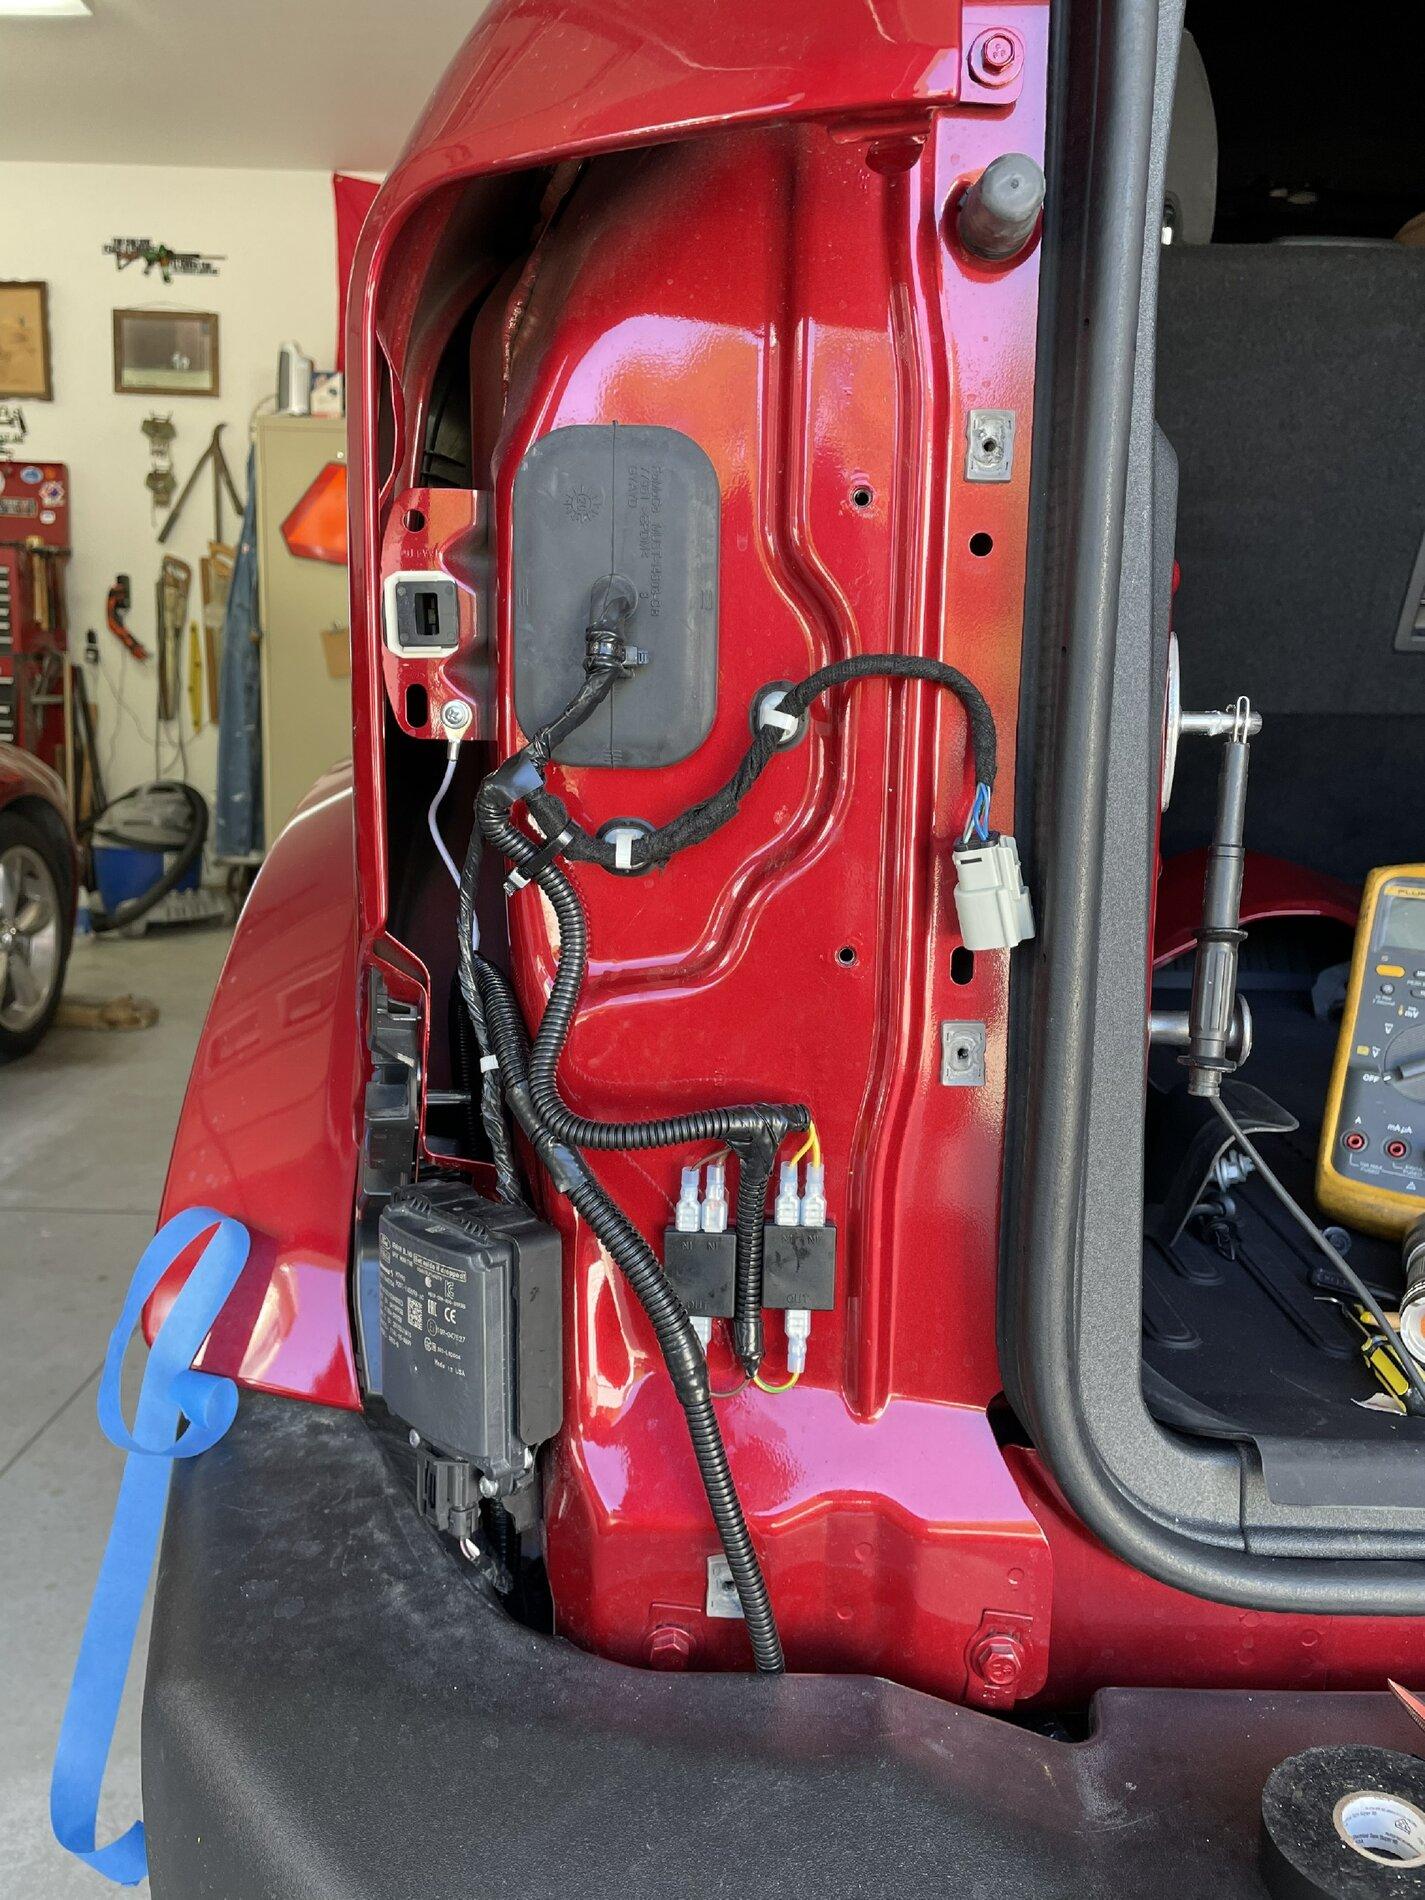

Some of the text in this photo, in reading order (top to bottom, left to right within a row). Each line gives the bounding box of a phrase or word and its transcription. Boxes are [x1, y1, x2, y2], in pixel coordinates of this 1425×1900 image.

[1362, 1073, 1380, 1083] OFF
[1354, 1116, 1362, 1124] A
[444, 1307, 457, 1324] CE
